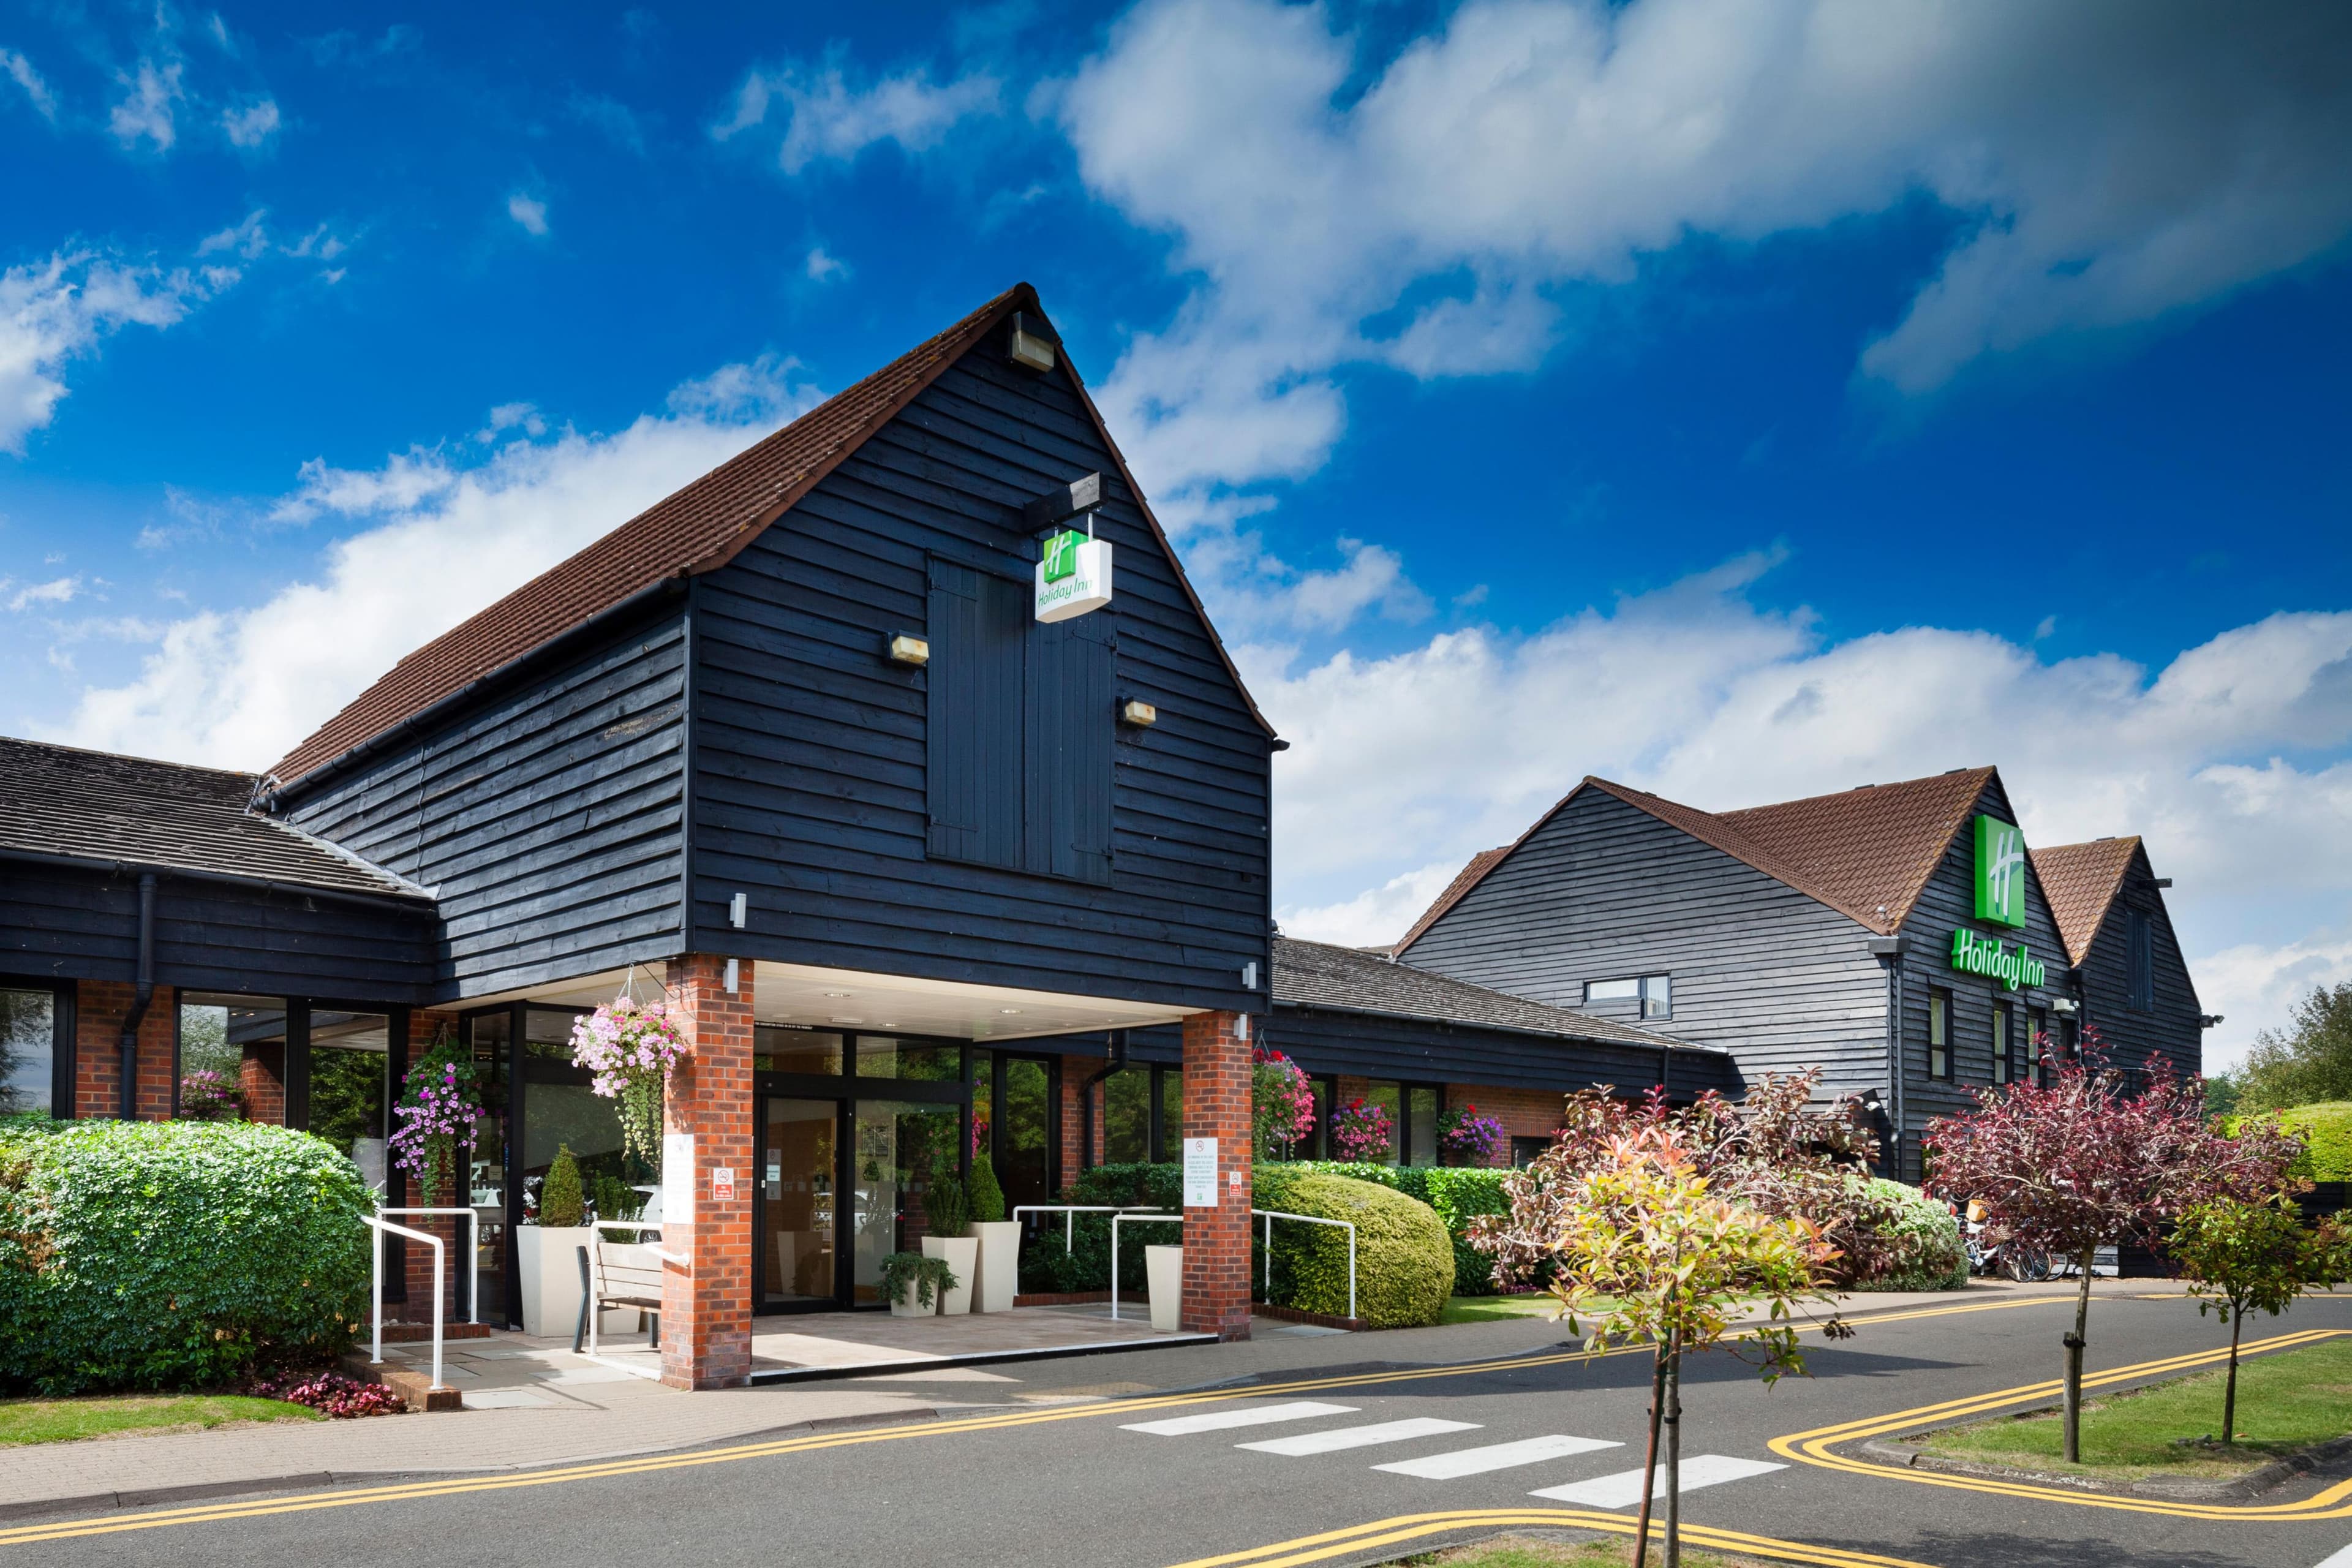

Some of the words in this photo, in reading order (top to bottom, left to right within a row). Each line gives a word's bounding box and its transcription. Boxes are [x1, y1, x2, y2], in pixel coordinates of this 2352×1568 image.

[1038, 584, 1072, 608] Holiday
[1074, 578, 1093, 593] Inn
[1958, 929, 2021, 991] Holiday
[2022, 946, 2045, 987] Inn
